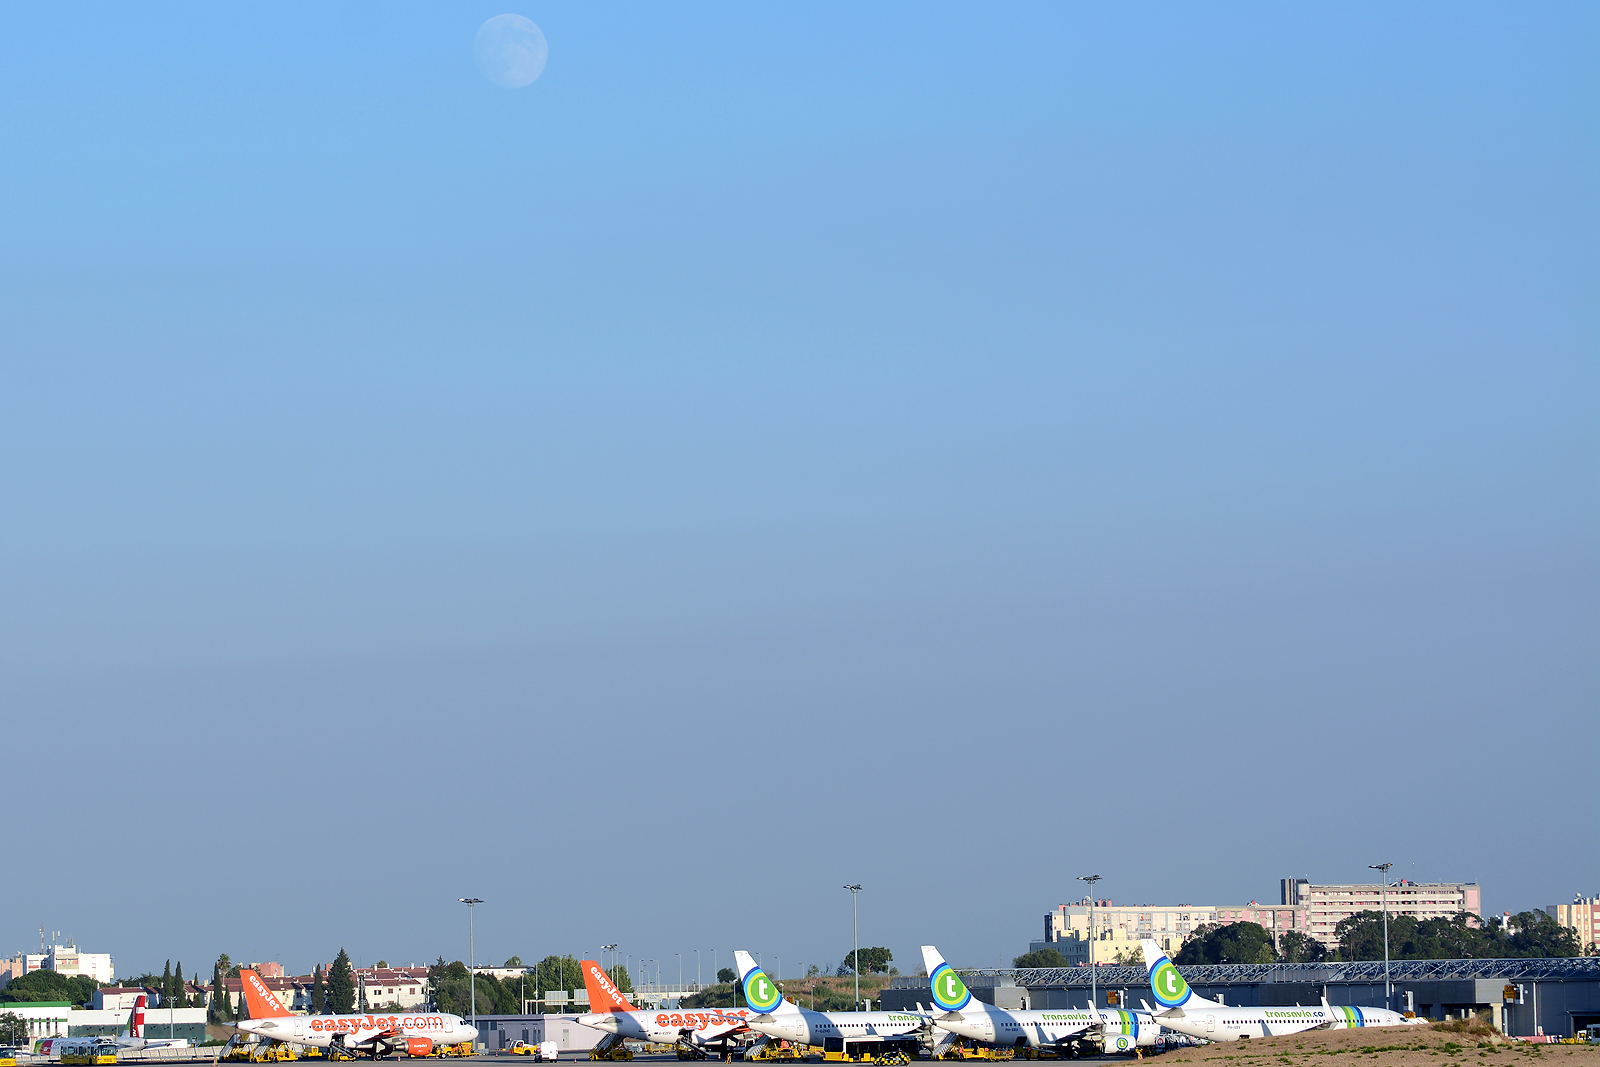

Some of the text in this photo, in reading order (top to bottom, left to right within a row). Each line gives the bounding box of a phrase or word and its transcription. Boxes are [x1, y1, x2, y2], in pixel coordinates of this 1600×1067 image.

[590, 966, 623, 1005] easyJet
[758, 979, 768, 1000] t
[946, 975, 956, 997] t
[1166, 970, 1177, 993] t
[249, 975, 280, 1012] easyJet
[310, 1015, 443, 1035] easyJet.com
[656, 1009, 749, 1031] easyJet
[1264, 1010, 1326, 1018] transavia.co
